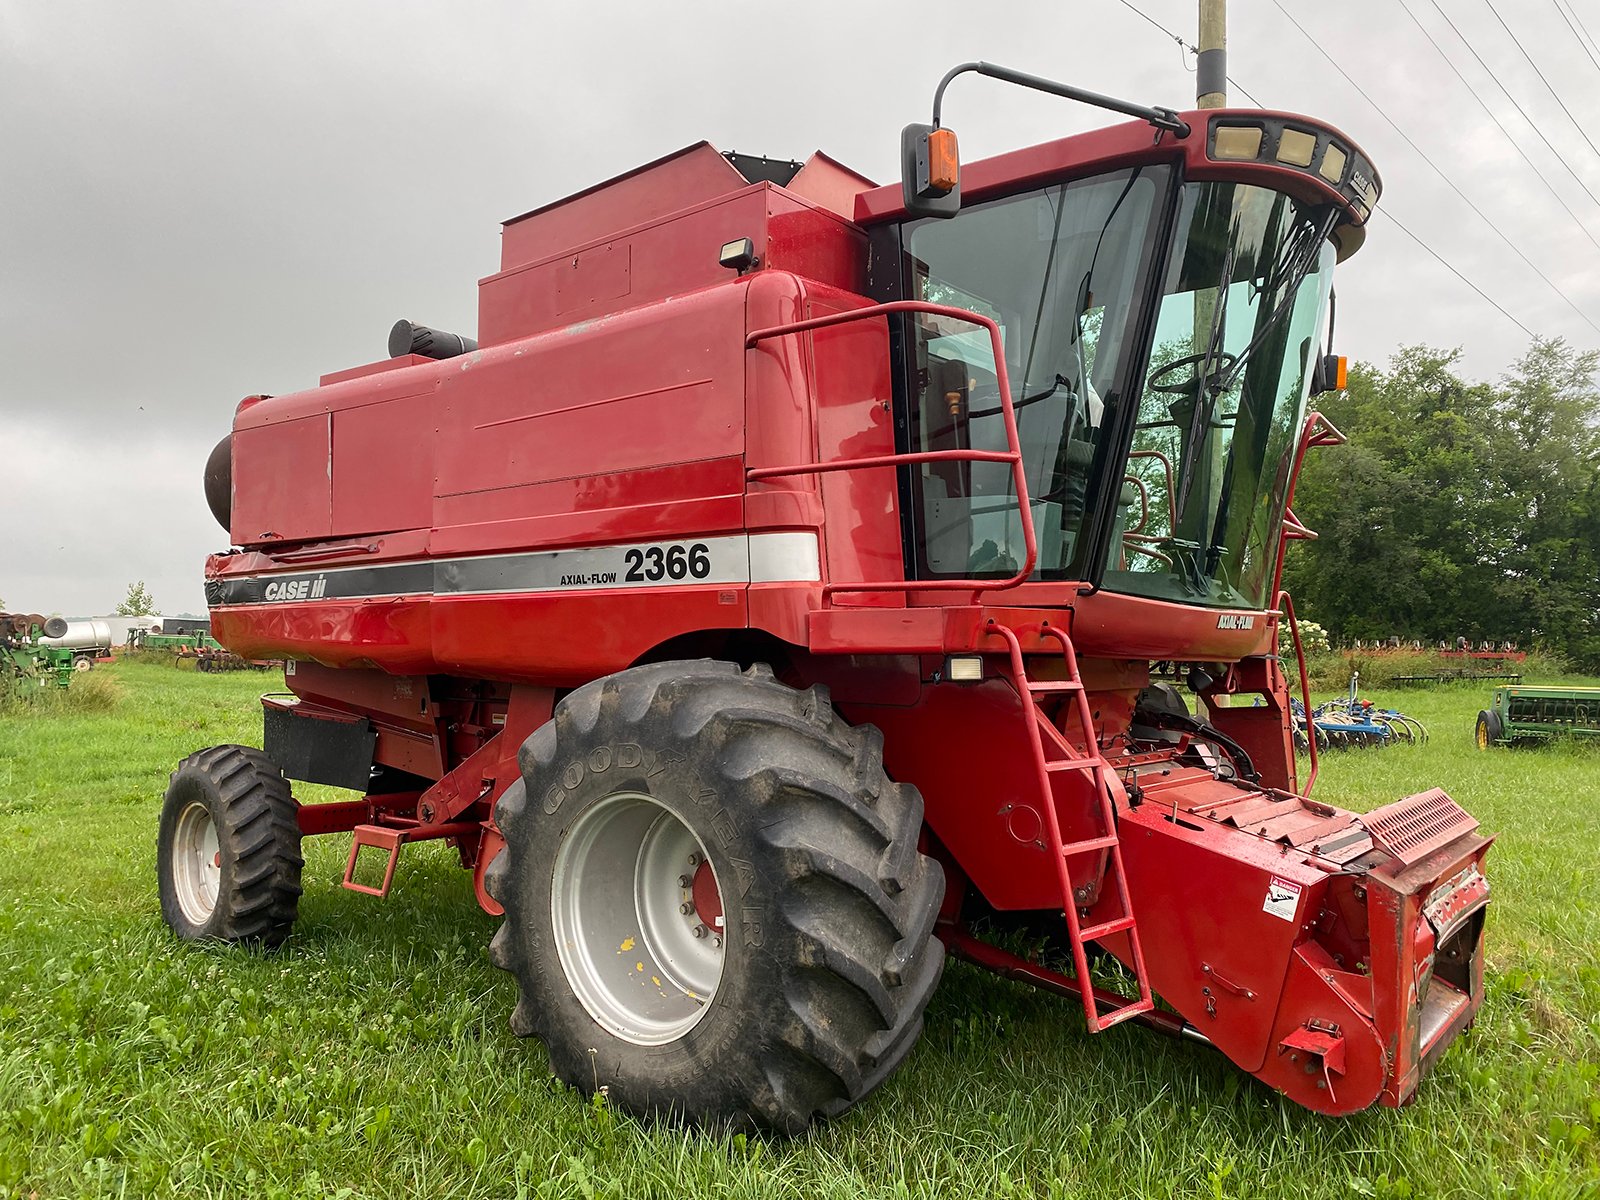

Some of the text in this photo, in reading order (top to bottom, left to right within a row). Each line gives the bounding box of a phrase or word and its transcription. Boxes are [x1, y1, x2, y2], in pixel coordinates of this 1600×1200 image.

[560, 543, 711, 585] AXIAL-FLOW 2366
[265, 580, 310, 600] CASE
[1217, 614, 1255, 630] AXIAL-FLOW
